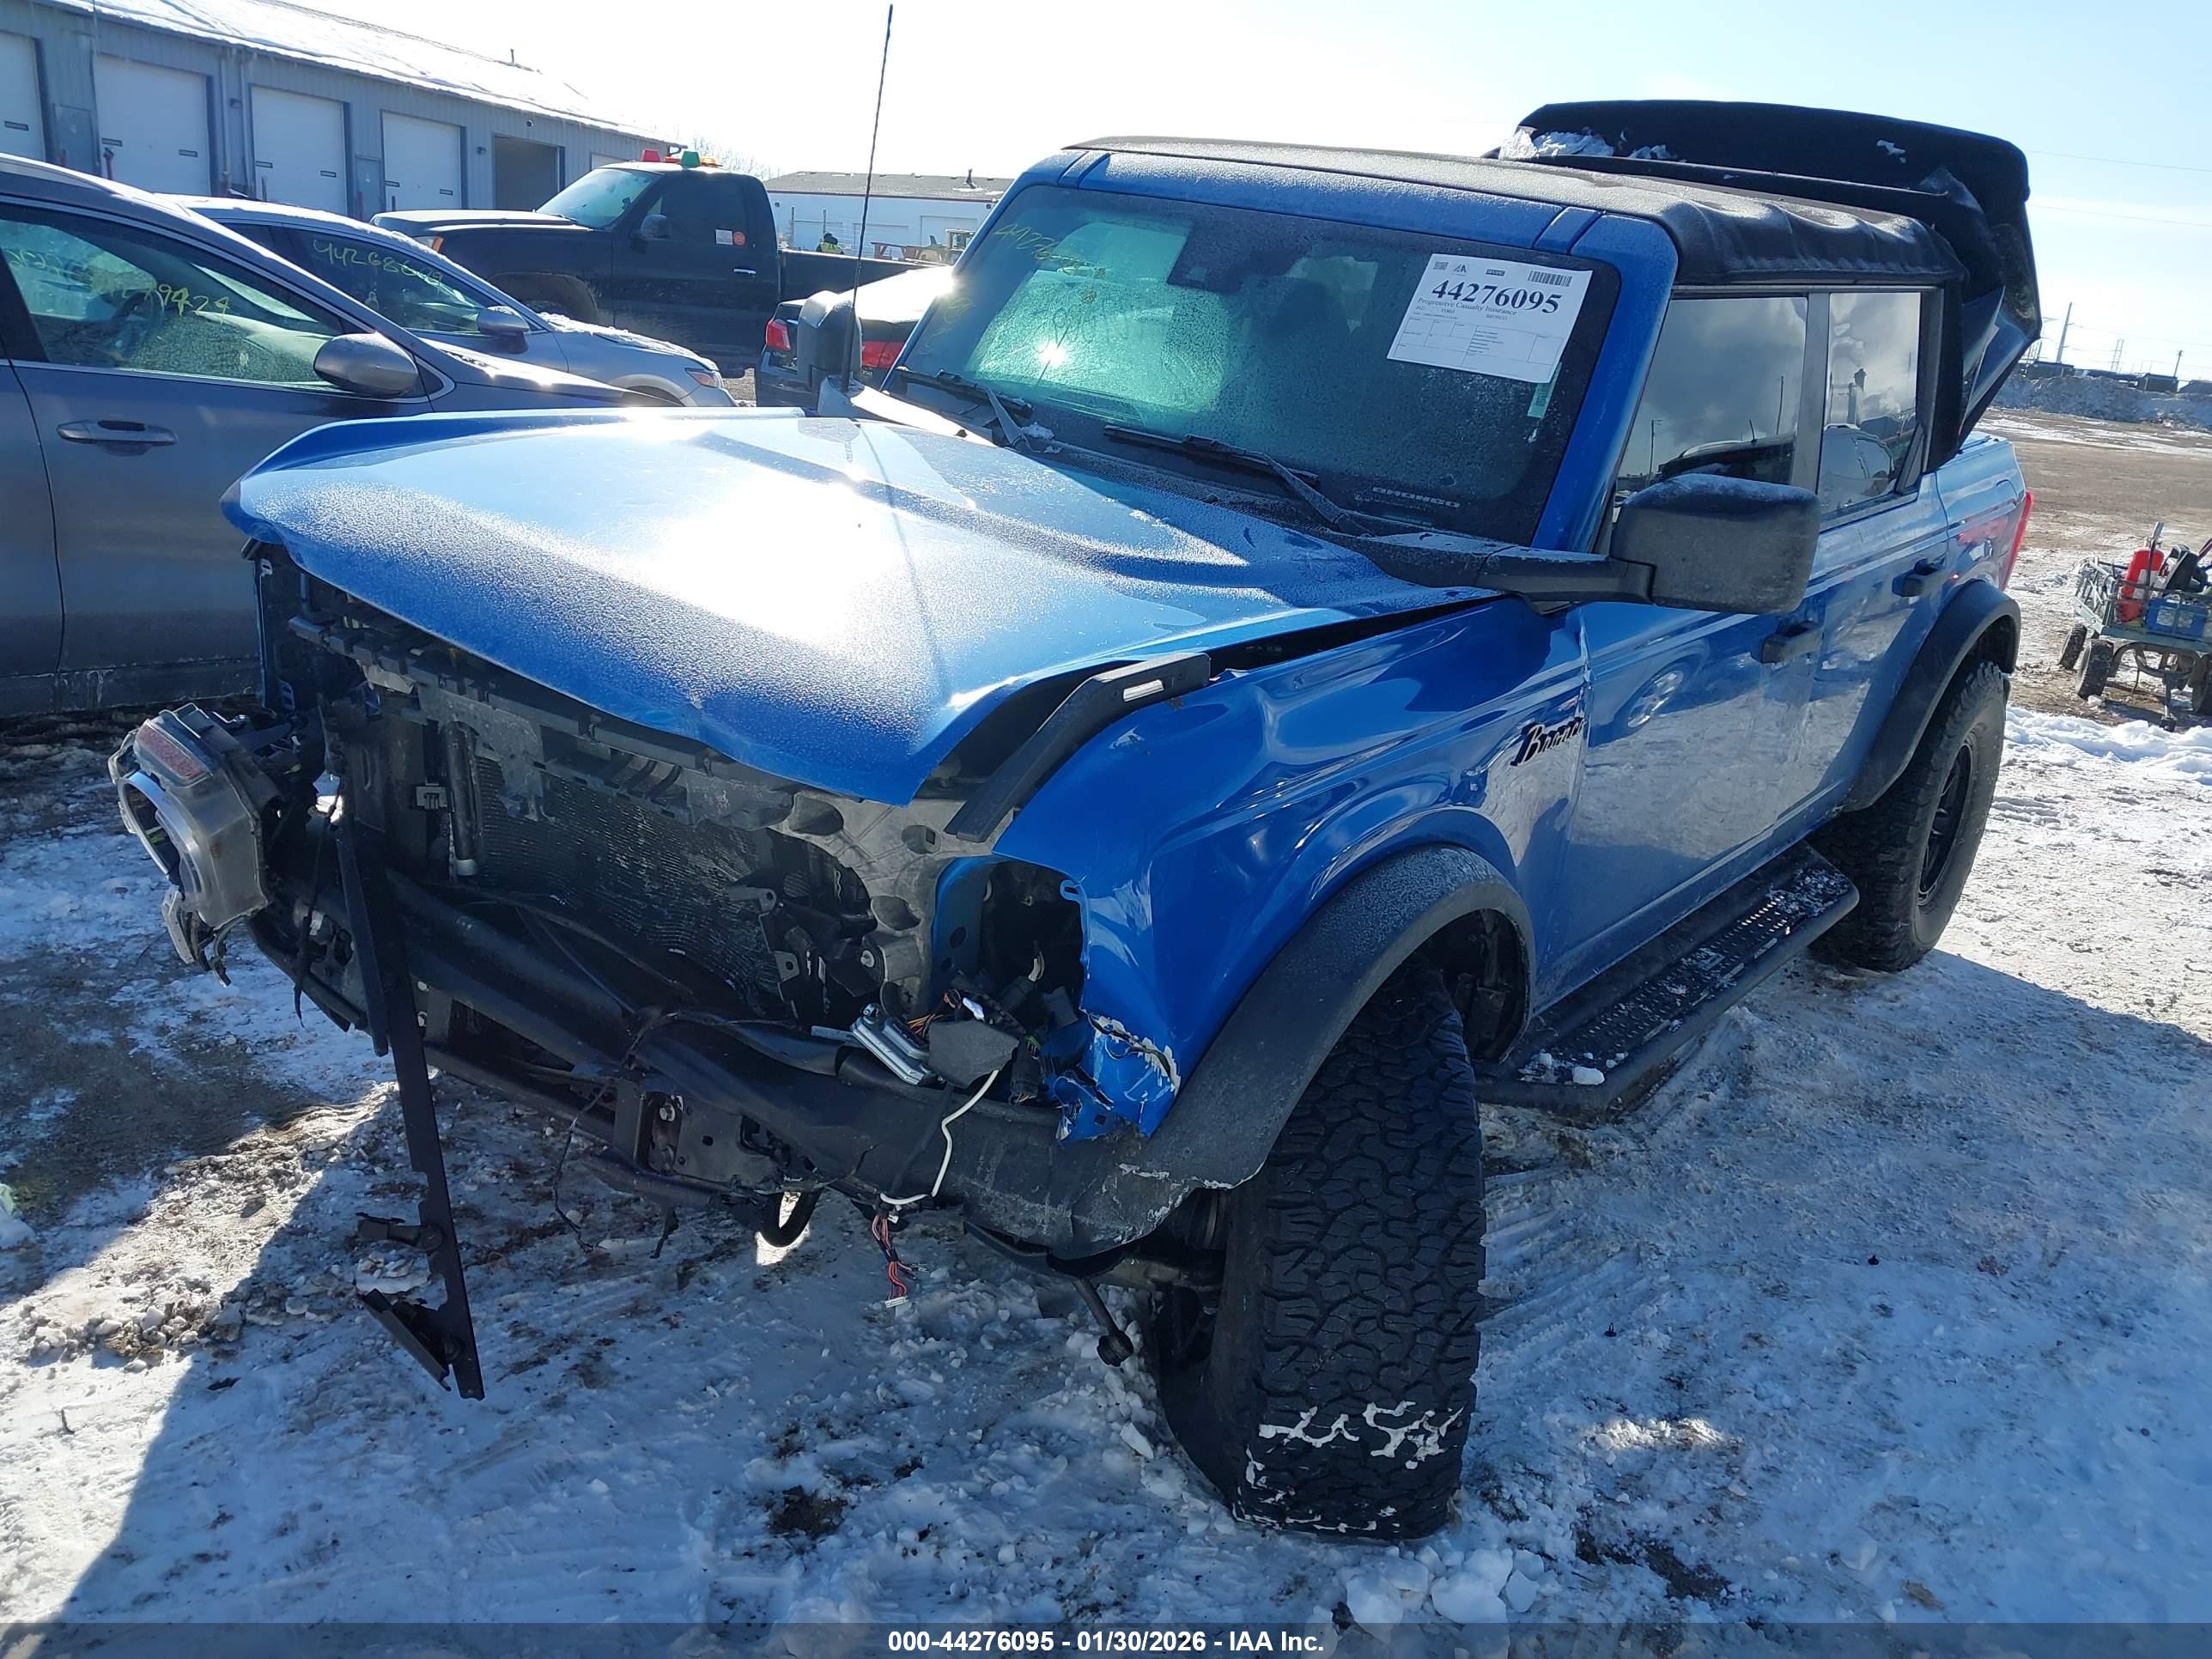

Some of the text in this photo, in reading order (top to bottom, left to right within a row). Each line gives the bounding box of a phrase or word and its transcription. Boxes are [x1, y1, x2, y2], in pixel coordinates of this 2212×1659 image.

[1418, 297, 1517, 316] Progressive Casualty Insurance
[1431, 280, 1563, 313] 44276095
